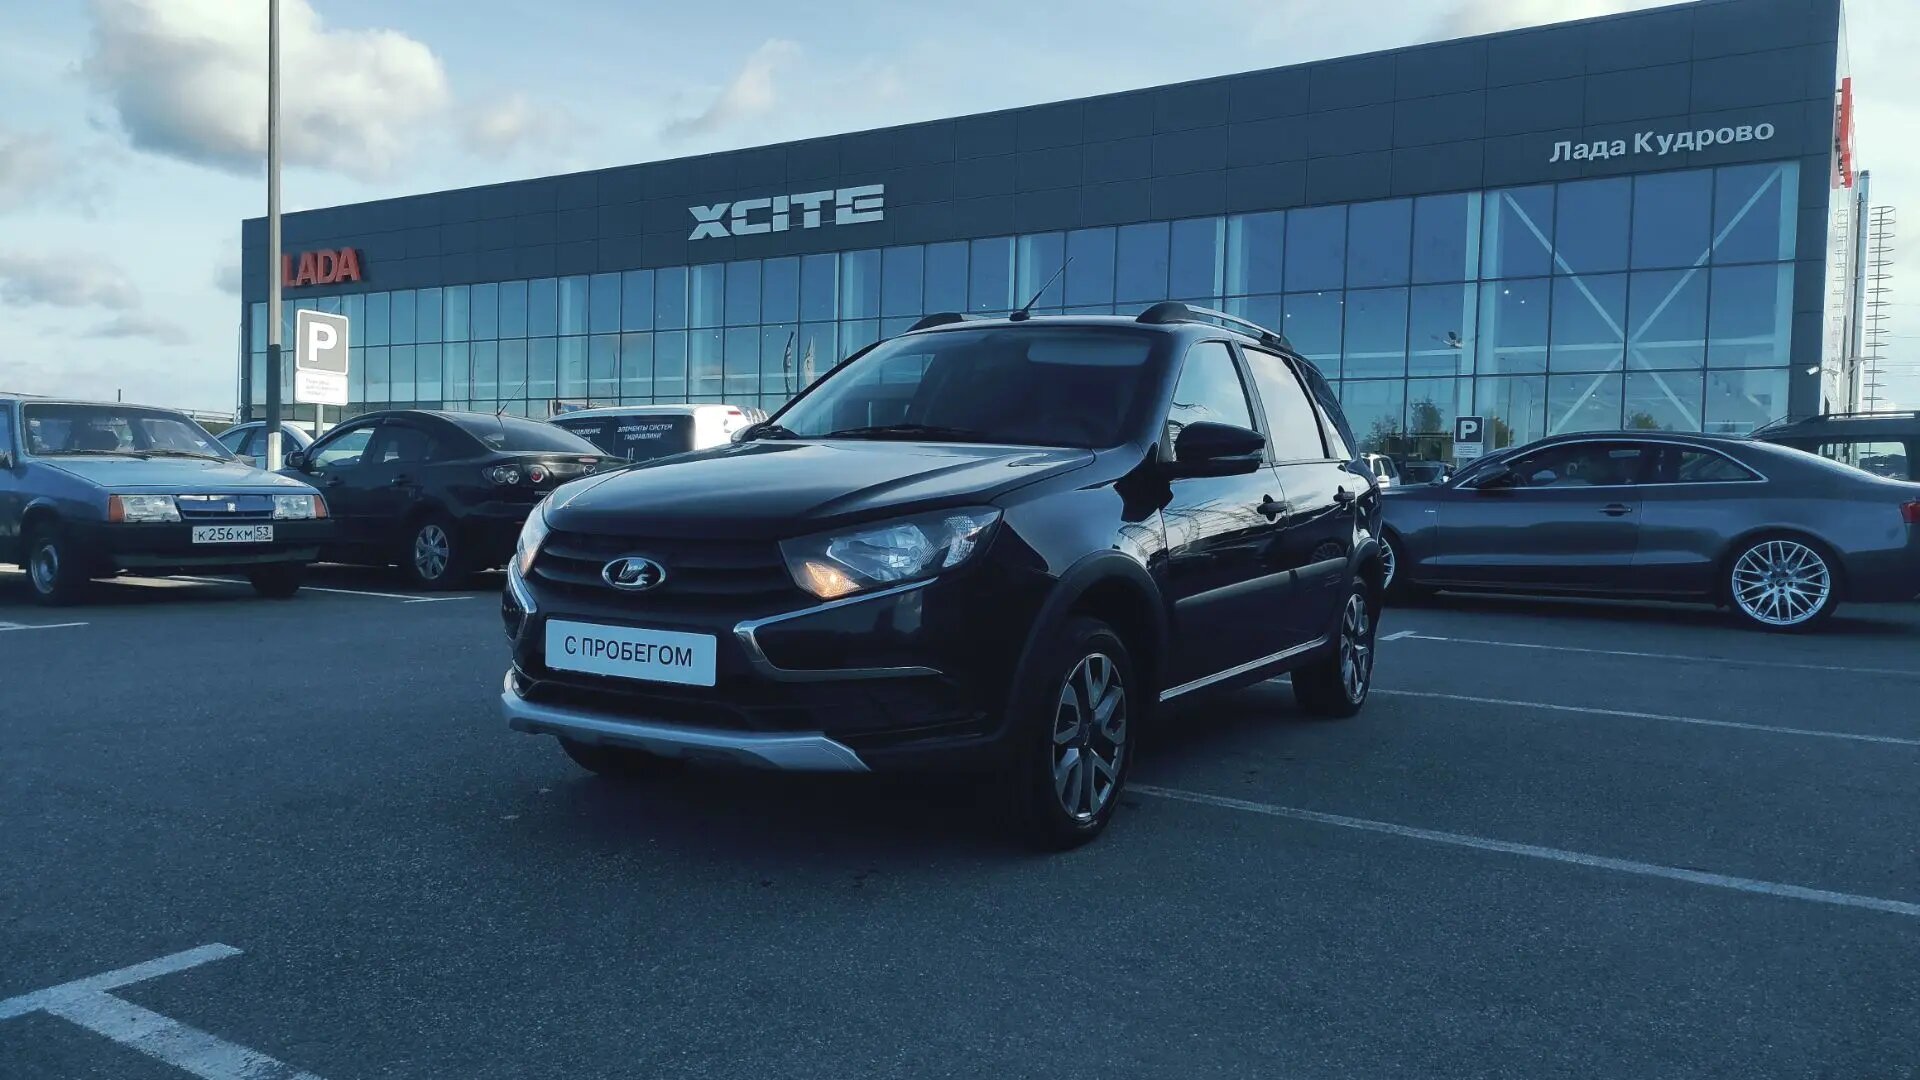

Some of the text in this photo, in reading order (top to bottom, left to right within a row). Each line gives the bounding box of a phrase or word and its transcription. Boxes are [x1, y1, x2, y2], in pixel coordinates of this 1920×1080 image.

[1549, 122, 1775, 163] Лада Кудрово
[688, 184, 884, 240] XCITE
[281, 246, 361, 287] LADA
[308, 321, 338, 362] P
[616, 423, 673, 433] ЭЛЕМЕНТЫ СИСТЕМ
[623, 432, 662, 441] ГИДРАВЛИКИ
[1460, 420, 1478, 440] P
[256, 526, 269, 537] 53
[564, 635, 692, 667] С ПРОБЕГОМ
